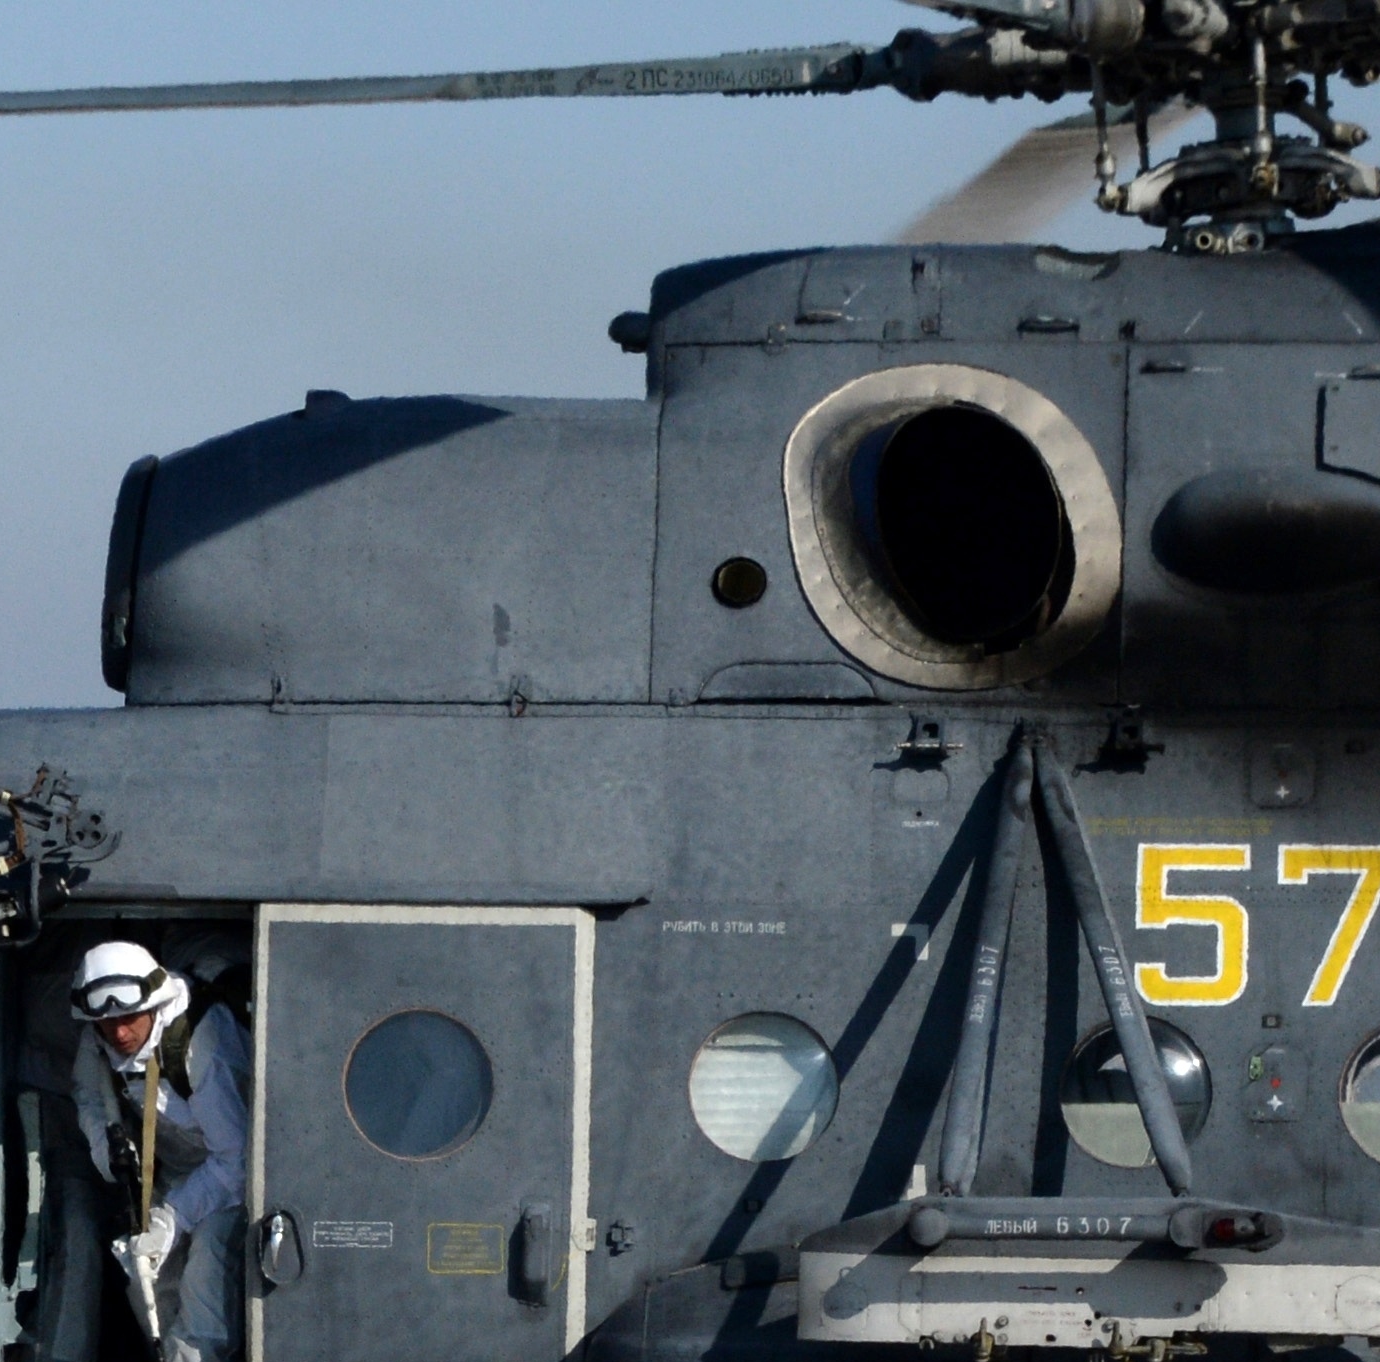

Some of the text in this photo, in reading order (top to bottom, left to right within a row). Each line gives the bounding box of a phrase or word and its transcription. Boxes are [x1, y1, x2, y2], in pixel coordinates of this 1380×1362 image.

[624, 70, 637, 90] 2
[642, 66, 668, 89] ПС
[662, 920, 707, 933] РУБИТЬ
[711, 920, 719, 933] В
[758, 921, 788, 935] ЗОНЕ
[976, 944, 1000, 987] 6307
[1098, 944, 1127, 986] 6307
[984, 1216, 1132, 1236] ЛЕВЫЙ 6307
